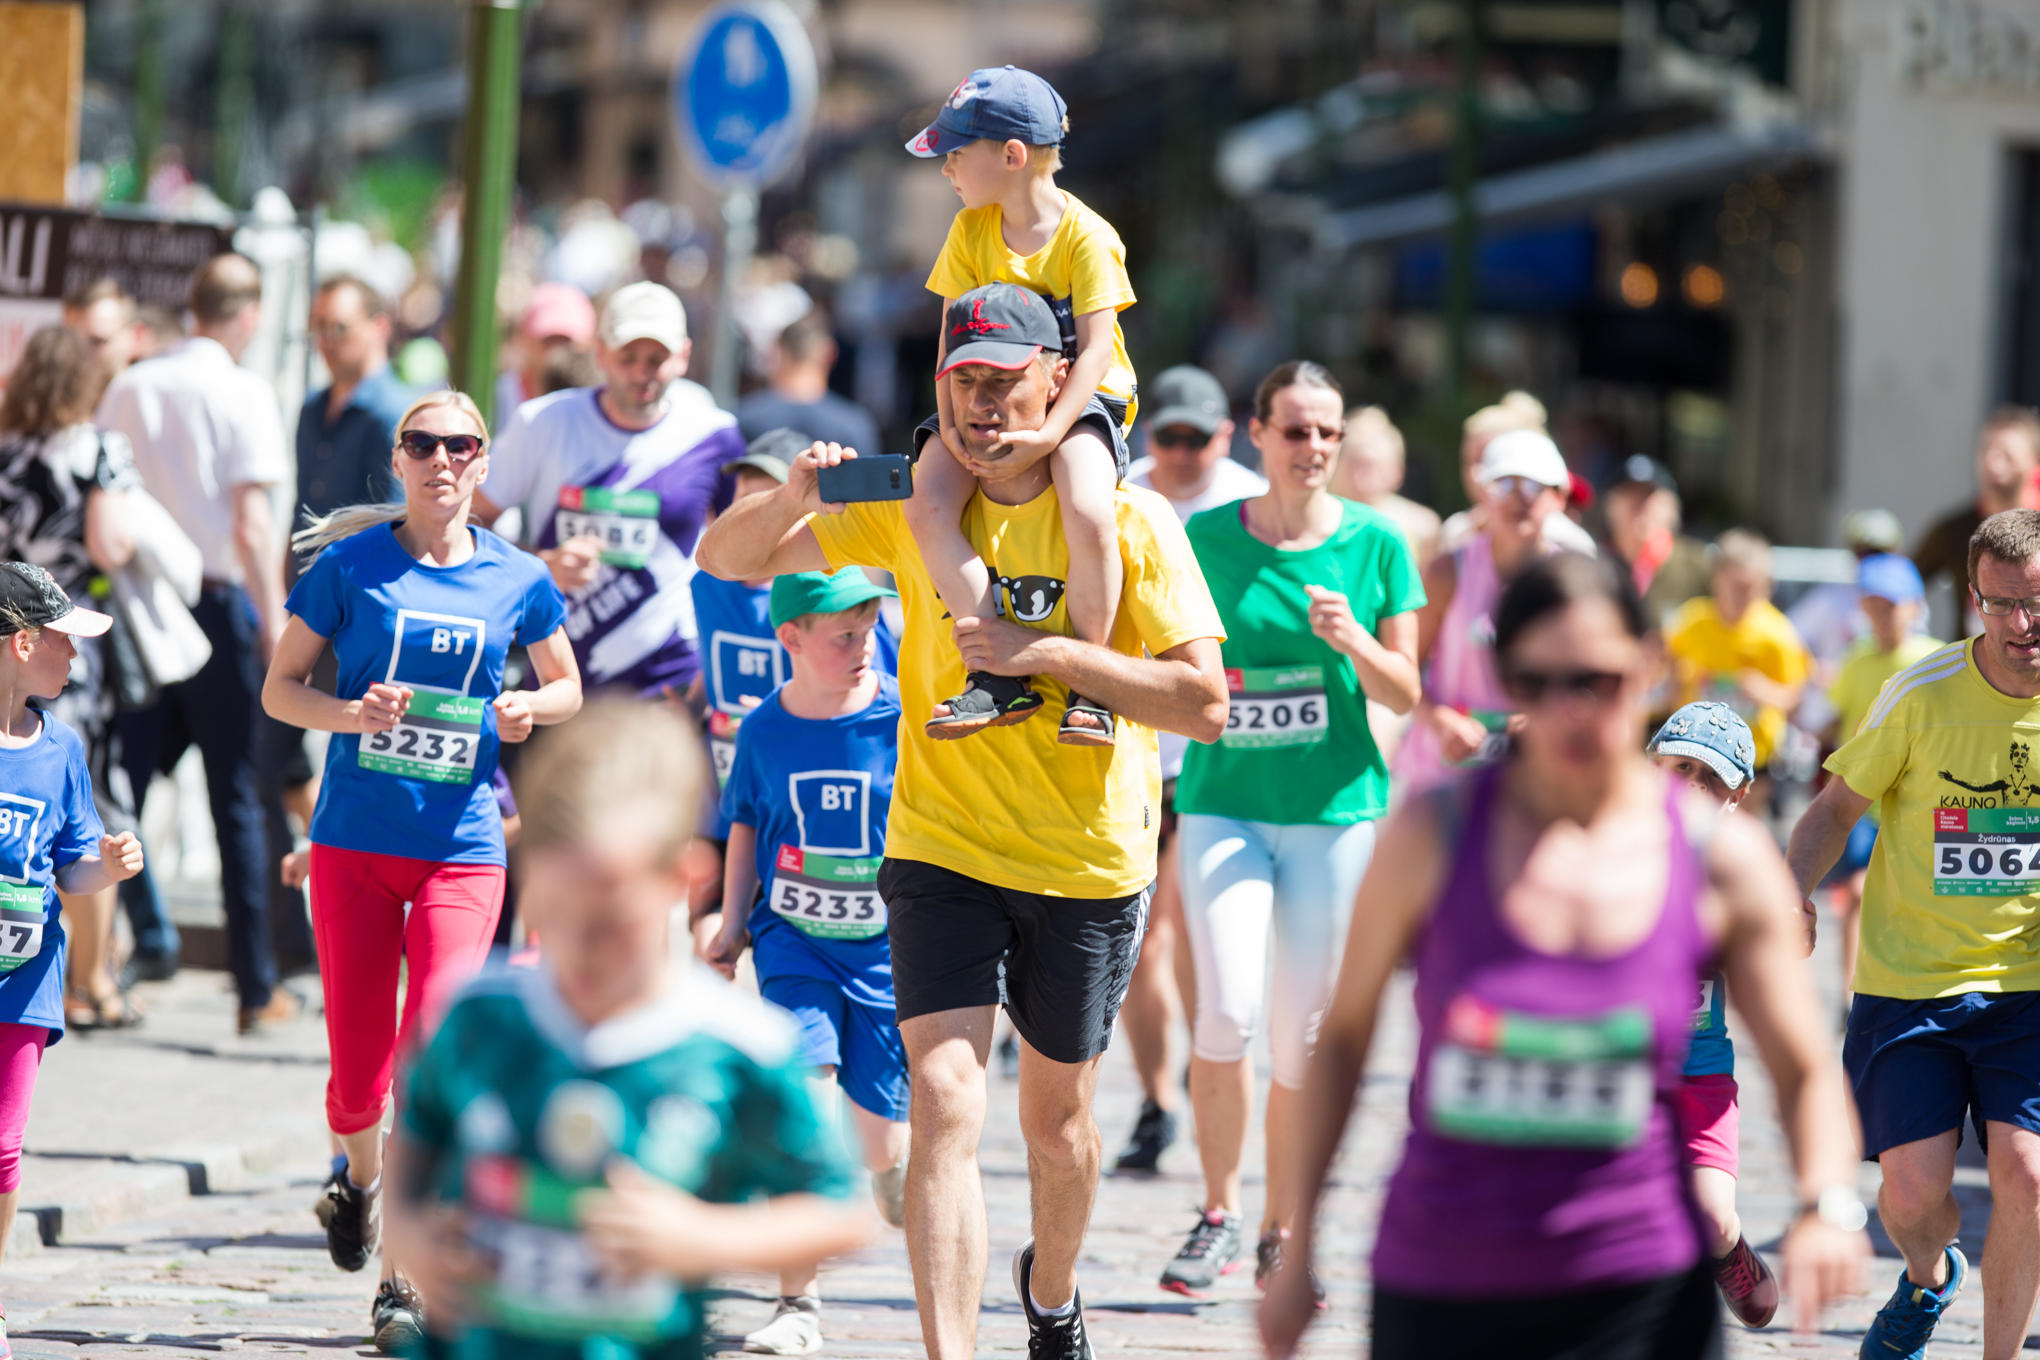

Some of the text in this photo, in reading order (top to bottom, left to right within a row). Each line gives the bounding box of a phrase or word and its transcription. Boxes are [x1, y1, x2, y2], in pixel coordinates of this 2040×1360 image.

[0, 213, 52, 294] LI
[431, 628, 471, 655] BT
[738, 648, 770, 678] BT
[1227, 701, 1319, 728] 5206
[370, 729, 469, 763] 5232
[821, 784, 857, 811] BT
[1940, 796, 1996, 809] KAUNO
[0, 808, 31, 838] BT
[1978, 833, 2016, 844] Žydrūnas
[28, 895, 41, 904] km
[780, 885, 874, 920] 5233
[0, 924, 33, 954] 7
